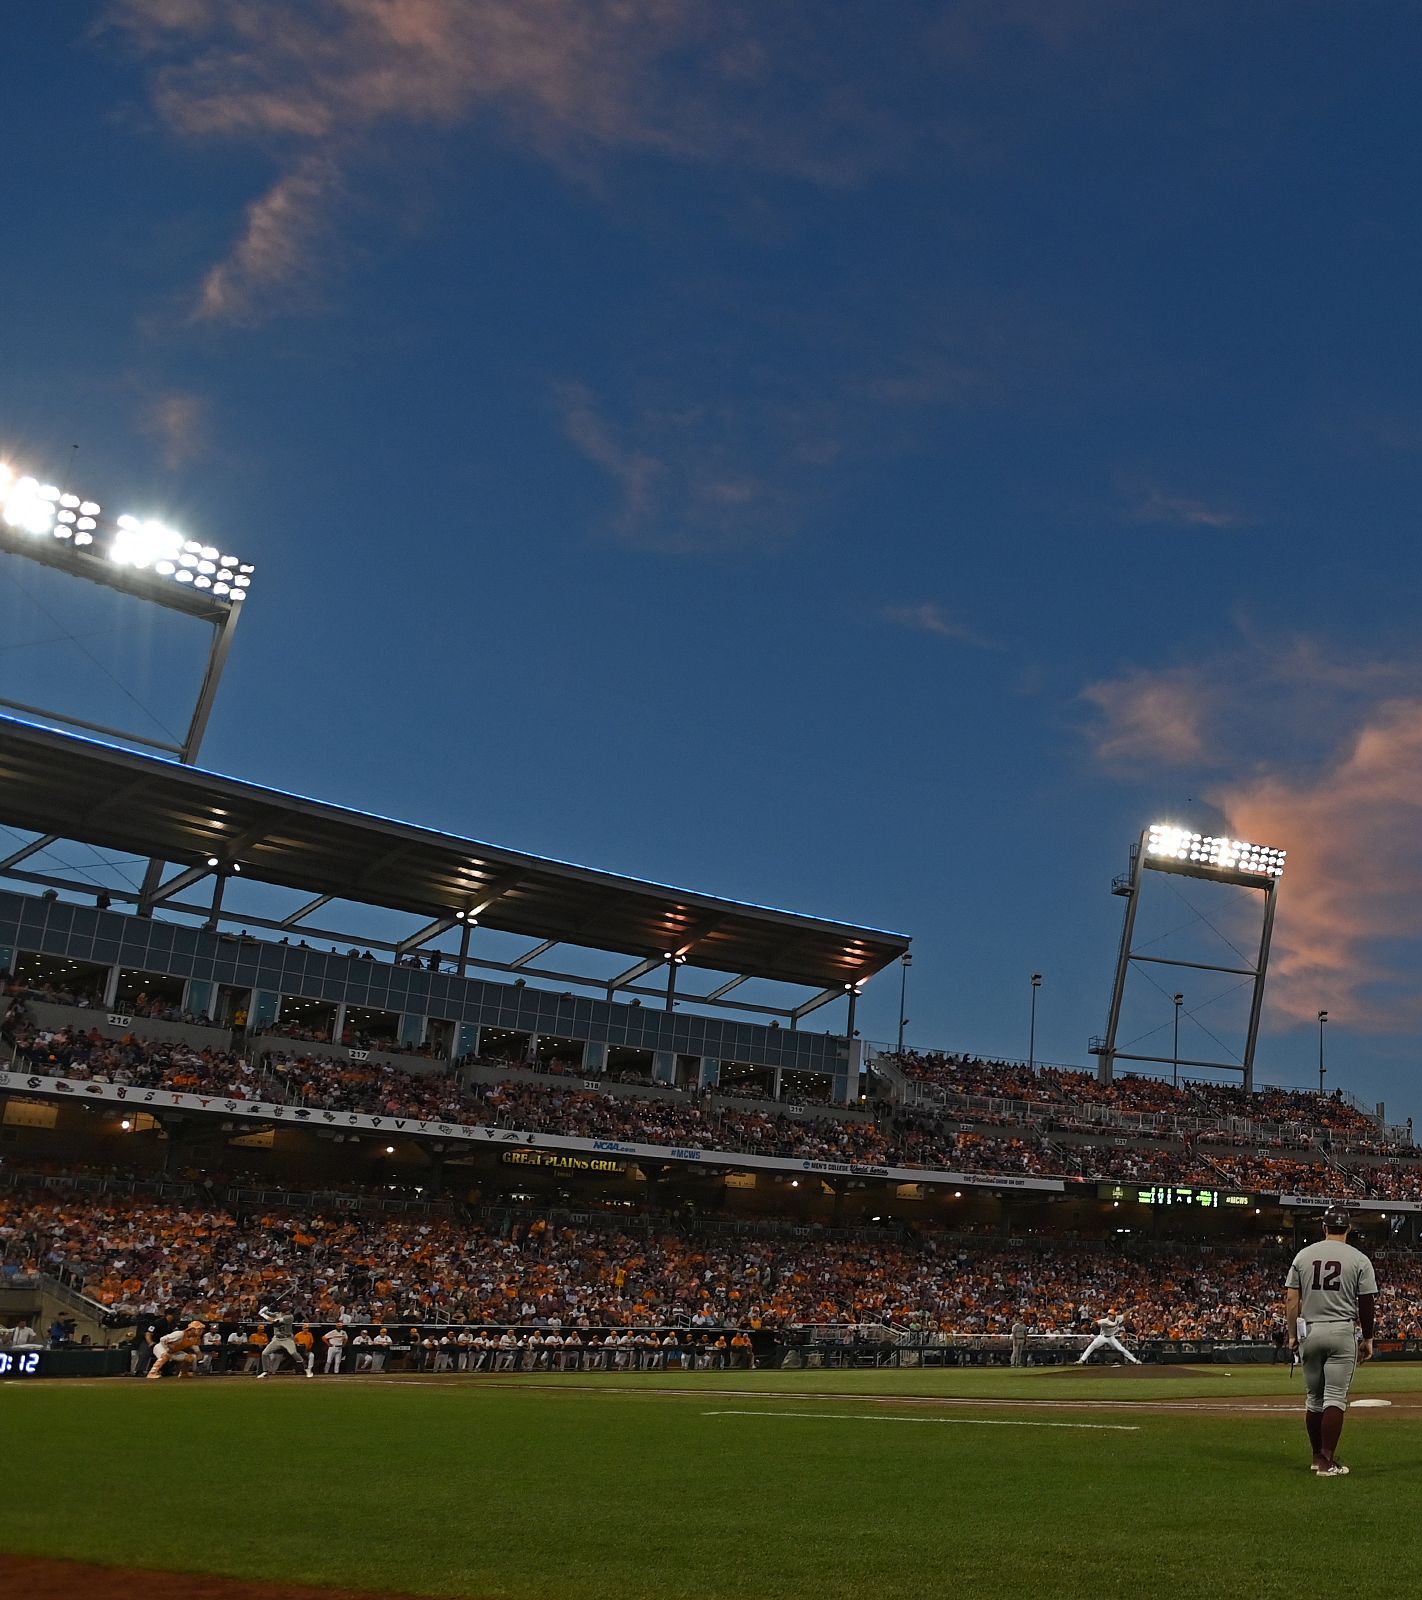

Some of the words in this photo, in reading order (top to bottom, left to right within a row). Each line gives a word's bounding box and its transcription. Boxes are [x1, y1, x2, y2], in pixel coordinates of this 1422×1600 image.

[110, 1016, 129, 1025] 216
[350, 1050, 367, 1058] 217
[593, 1140, 636, 1153] NCAA.com
[671, 1149, 701, 1159] #MCWS
[545, 1156, 589, 1169] PLAINS
[1311, 1260, 1342, 1291] 12
